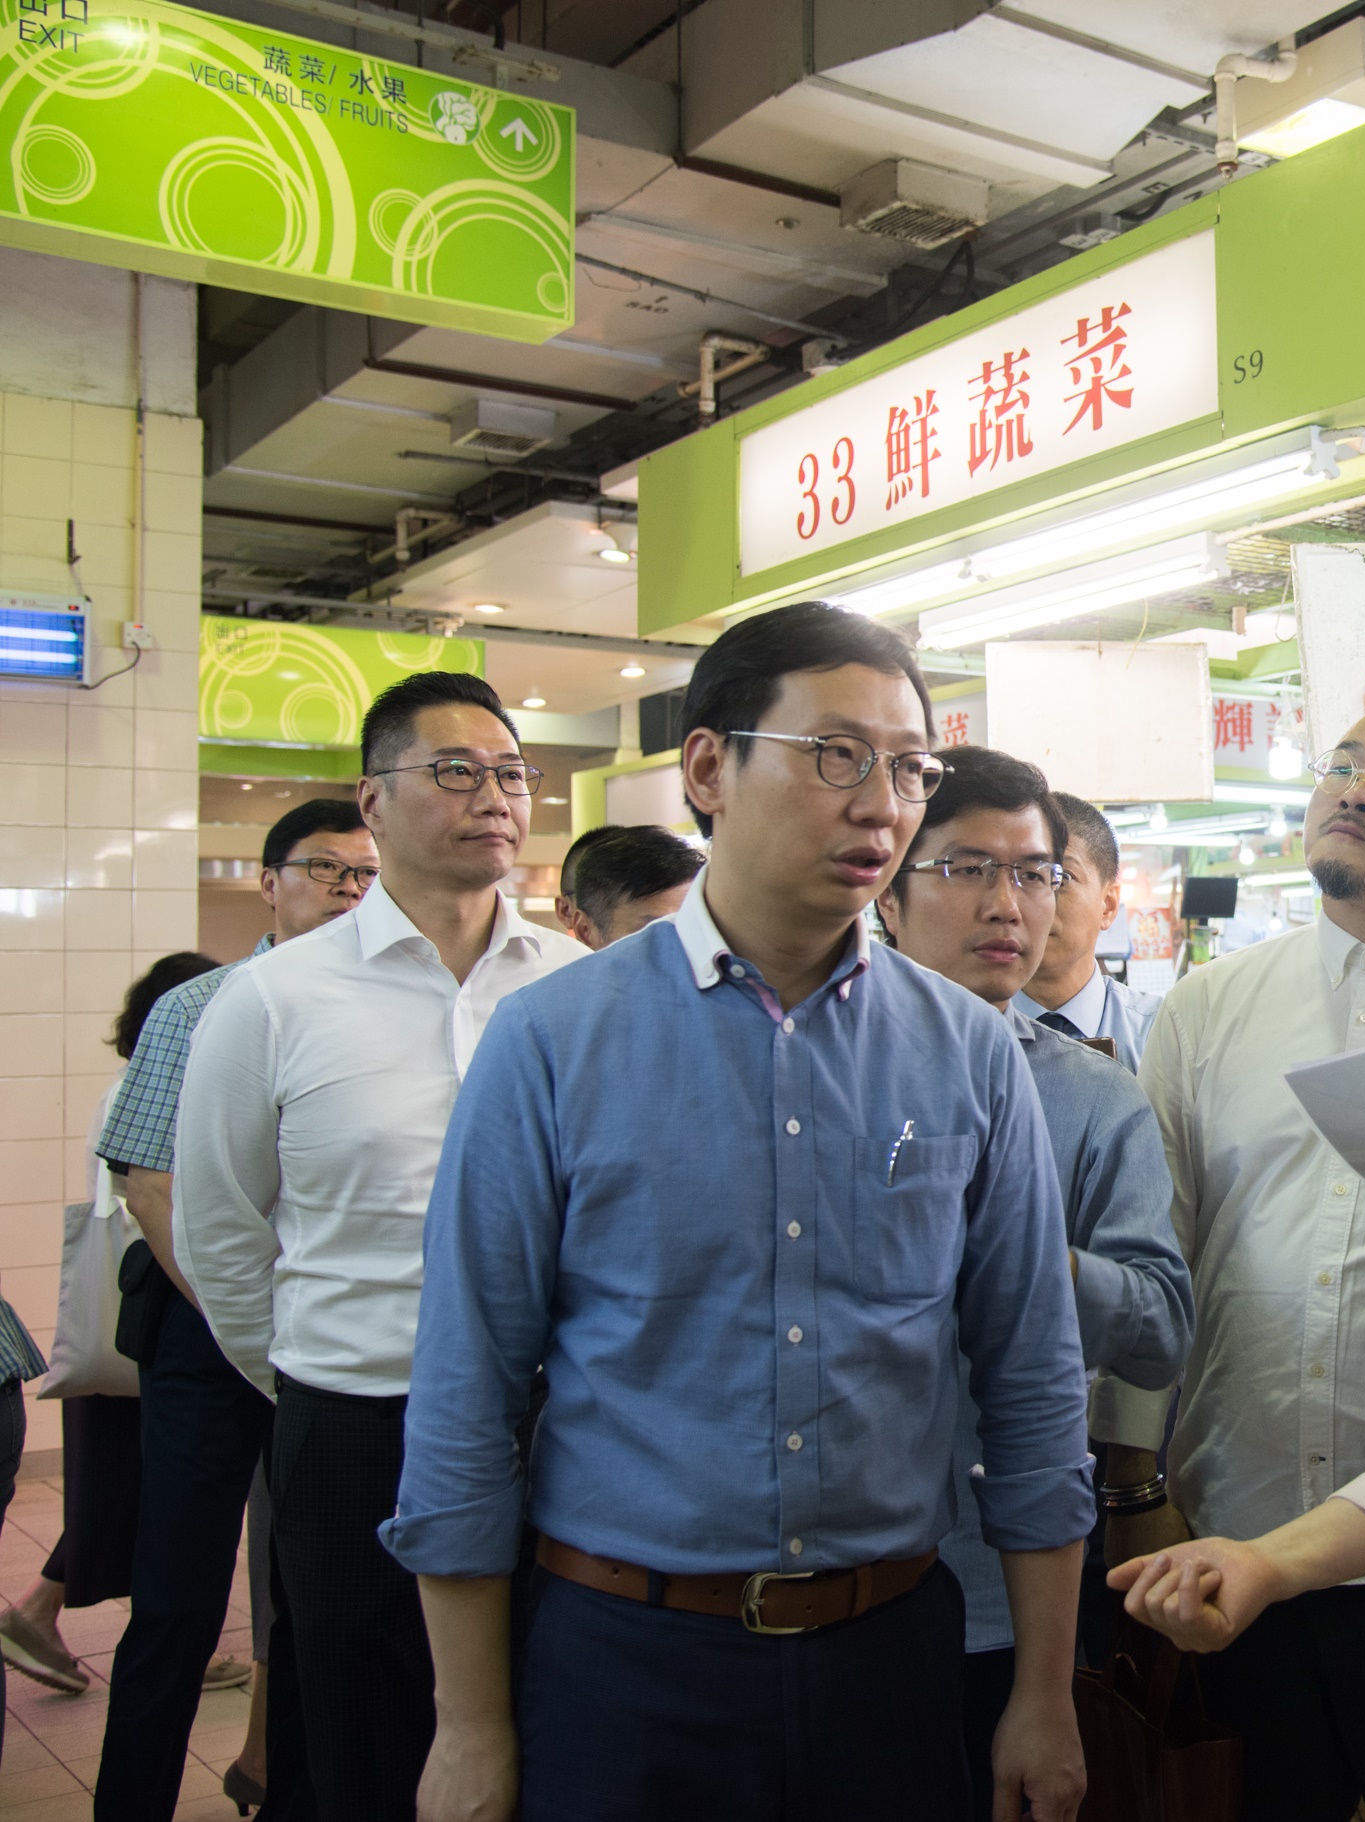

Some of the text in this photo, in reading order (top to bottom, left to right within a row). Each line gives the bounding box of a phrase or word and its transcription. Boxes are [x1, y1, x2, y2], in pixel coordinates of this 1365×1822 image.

[19, 19, 84, 53] EXIT
[190, 61, 409, 134] VEGETABLES/ FRUITS
[348, 68, 407, 105] 水果
[1233, 349, 1264, 385] S9
[884, 302, 1135, 511] 鮮蔬菜
